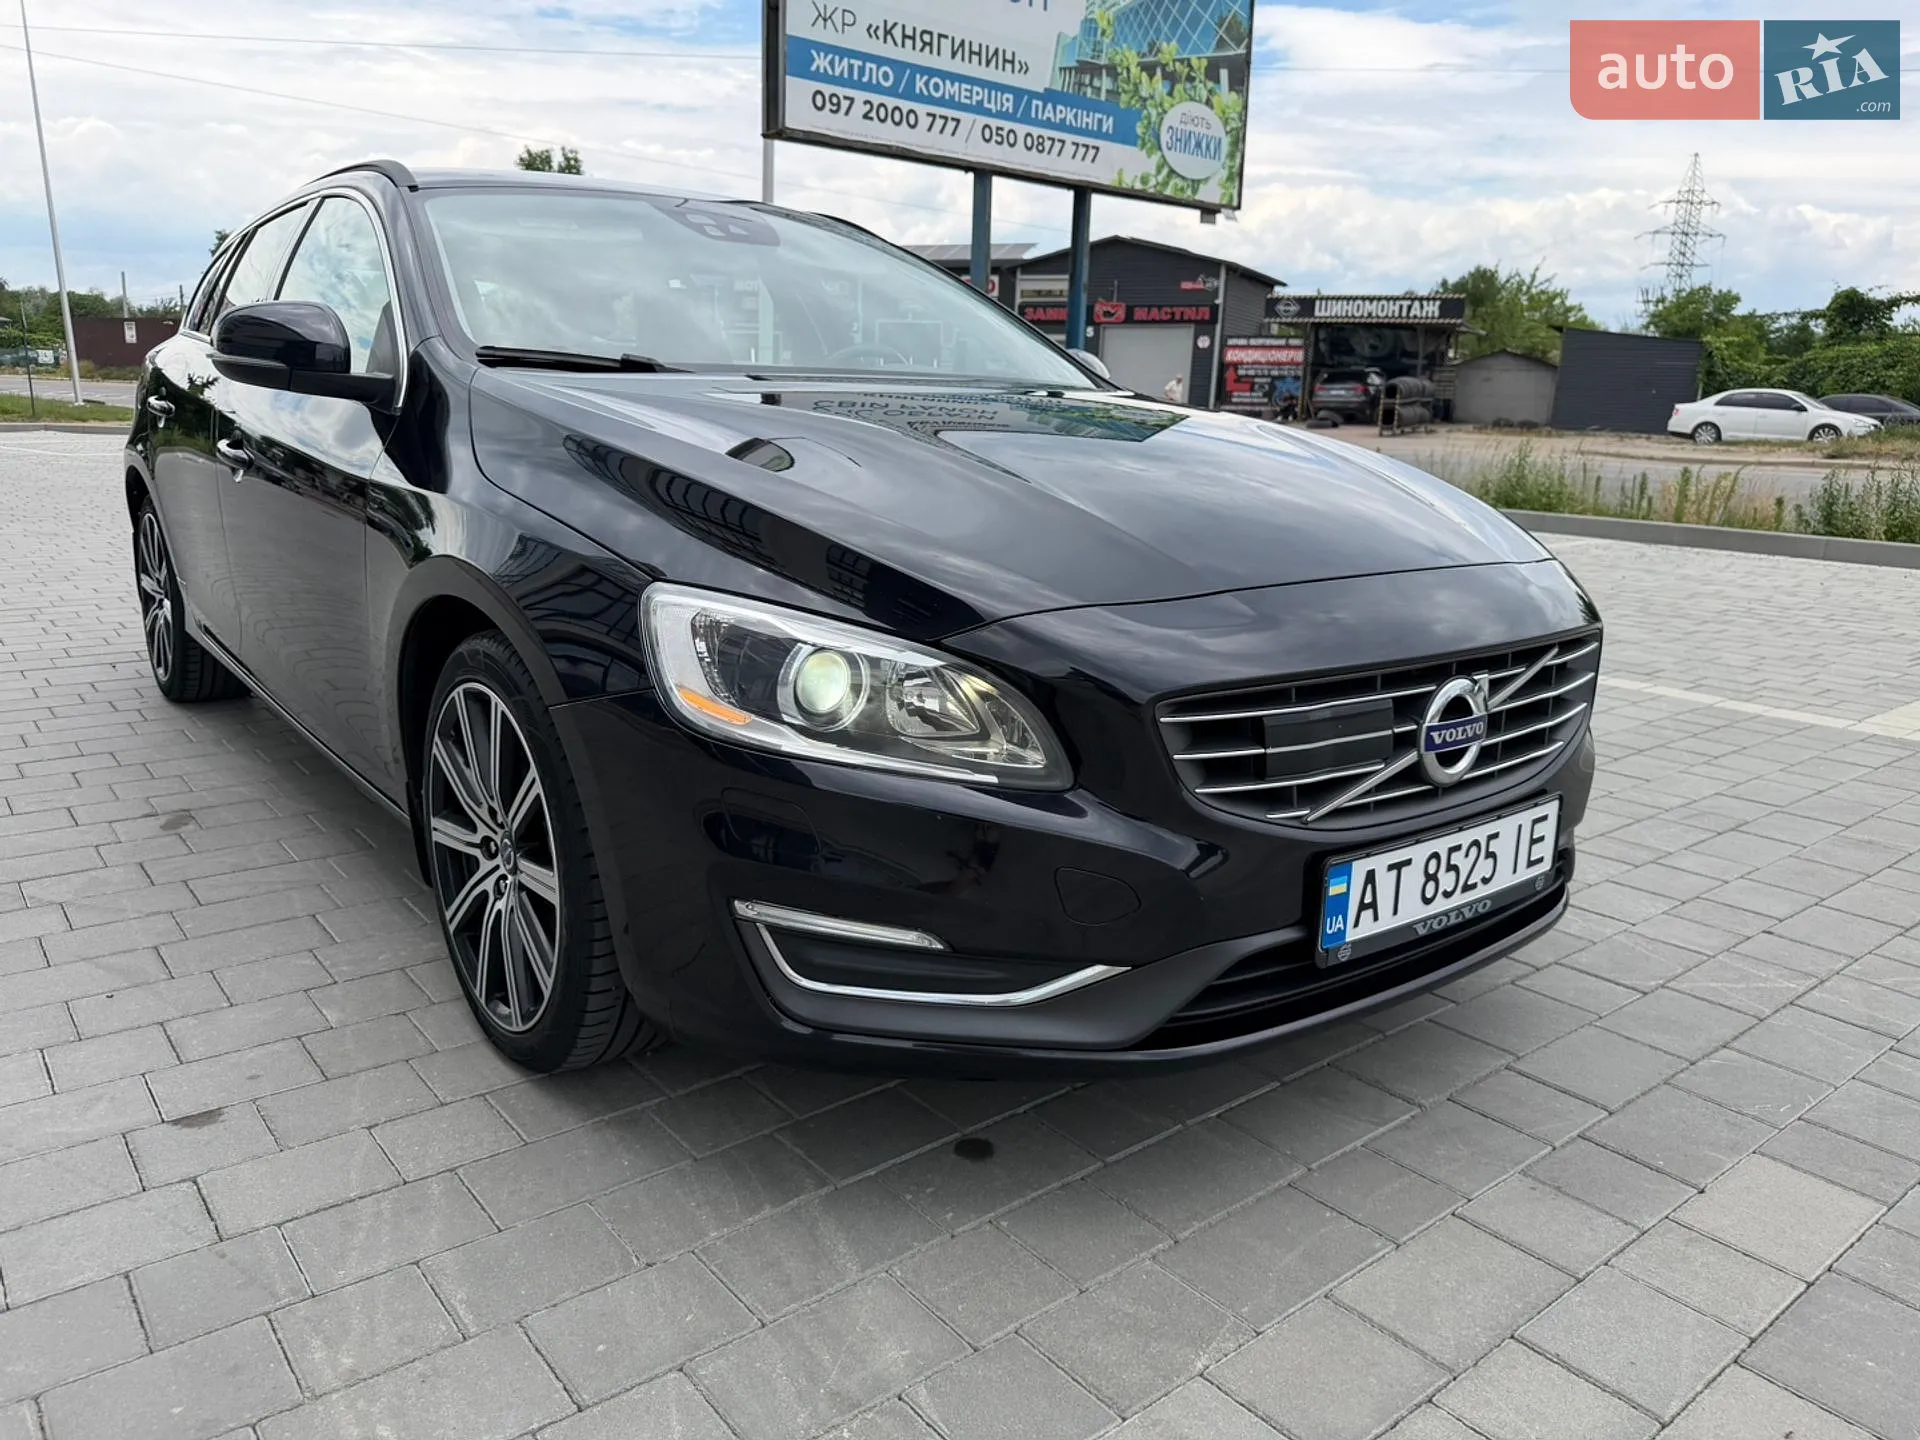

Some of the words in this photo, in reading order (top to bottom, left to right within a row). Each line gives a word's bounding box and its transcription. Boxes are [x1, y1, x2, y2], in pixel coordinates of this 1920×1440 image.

[811, 0, 857, 34] ЖР
[866, 19, 1029, 75] «КНЯГИНИН»
[810, 49, 894, 87] ЖИТЛО
[915, 73, 1014, 113] КОМЕРЦІЯ
[1031, 99, 1114, 134] ПАРКІНГИ
[811, 90, 855, 117] 097
[862, 100, 918, 130] 2000
[926, 112, 961, 137] 777
[981, 124, 1018, 148] 050
[1023, 132, 1066, 157] 0877
[1071, 141, 1100, 164] 777
[1165, 125, 1222, 161] ЗНИЖКИ
[1134, 307, 1210, 321] МАСТИЛ
[1314, 299, 1441, 318] ШИНОМОНТАЖ
[1429, 722, 1484, 745] VOLVO
[1353, 858, 1413, 929] AT
[1421, 831, 1500, 905] 8525
[1512, 813, 1549, 875] IE
[1326, 915, 1345, 934] UA
[1413, 900, 1492, 936] VOLVO
